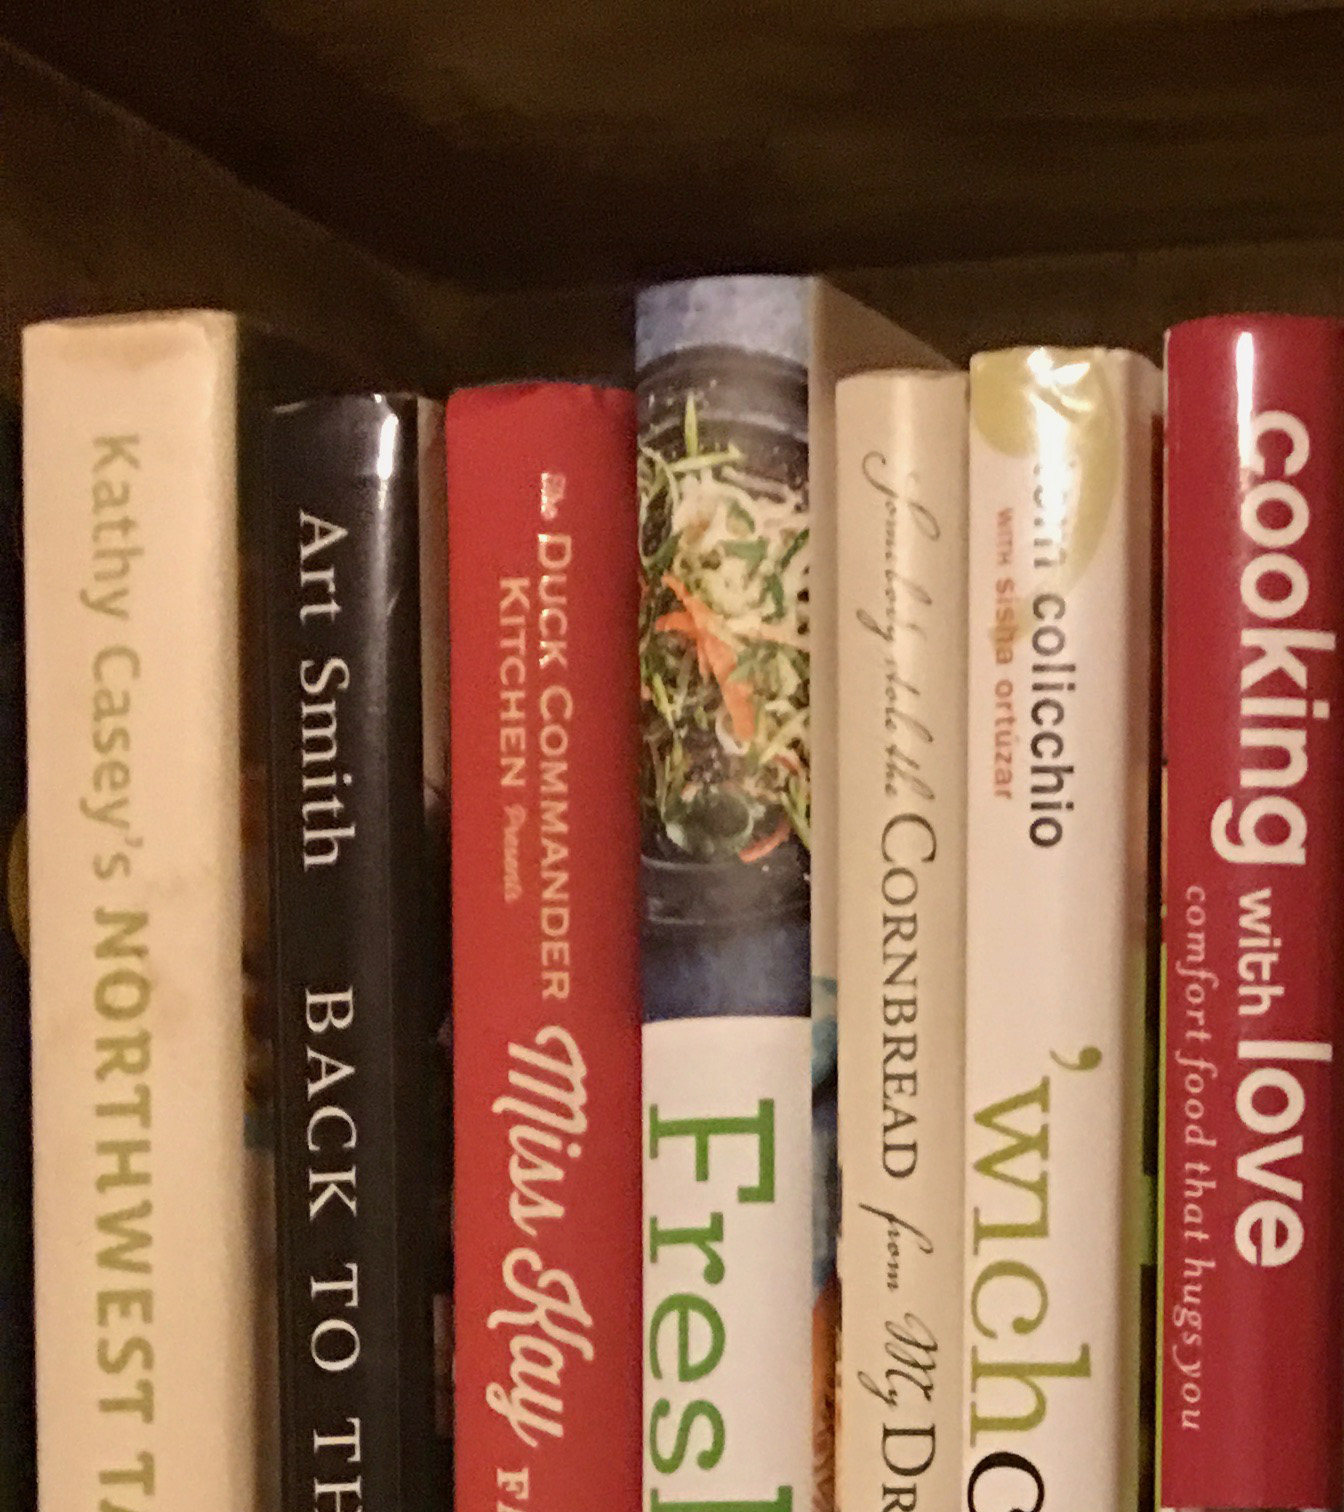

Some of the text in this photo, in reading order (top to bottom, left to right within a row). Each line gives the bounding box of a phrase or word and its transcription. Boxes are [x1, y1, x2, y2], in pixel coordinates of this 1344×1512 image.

[80, 432, 144, 619] Kathy
[538, 532, 572, 667] DUCK
[80, 645, 145, 882] Casey's
[299, 510, 356, 871] Art Smith
[498, 578, 532, 790] KITCHEN
[884, 744, 935, 802] the
[1029, 595, 1077, 848] colicchio
[538, 685, 573, 1001] COMMANDER
[1210, 409, 1336, 1268] cooking with love
[303, 985, 359, 1218] BACK
[879, 811, 937, 1179] CORNBREAD
[93, 906, 154, 1424] NORTHWEST
[485, 1025, 595, 1448] Miss Kay
[859, 1203, 933, 1293] from
[1171, 886, 1219, 1431] comfort food that hugs you
[310, 1262, 361, 1373] TO
[858, 1312, 938, 1408] My
